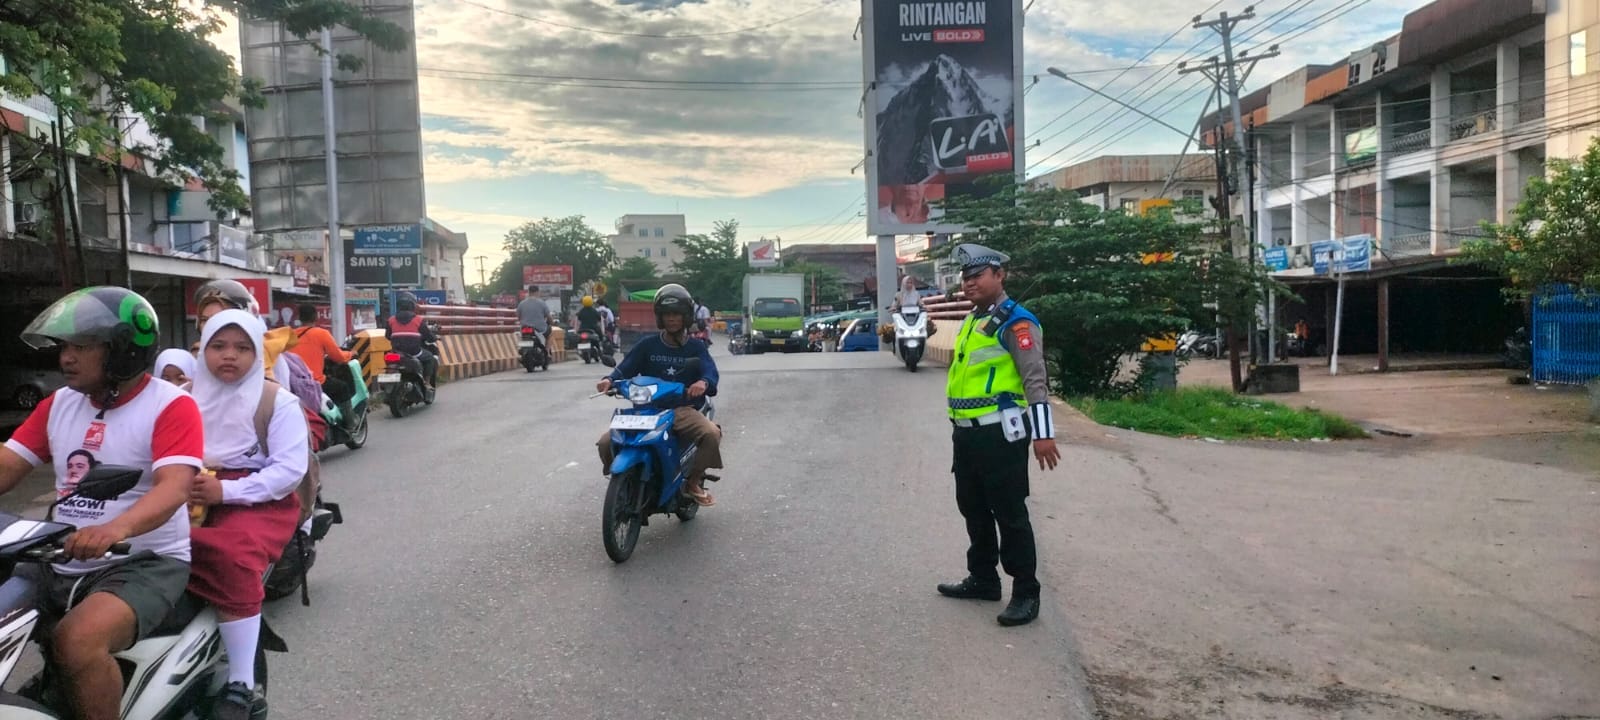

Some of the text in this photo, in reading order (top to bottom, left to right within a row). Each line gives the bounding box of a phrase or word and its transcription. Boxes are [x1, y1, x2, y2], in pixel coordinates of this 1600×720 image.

[899, 1, 986, 26] RINTANGAN
[901, 31, 970, 42] LIVE BOLD
[350, 256, 412, 267] SAMSG
